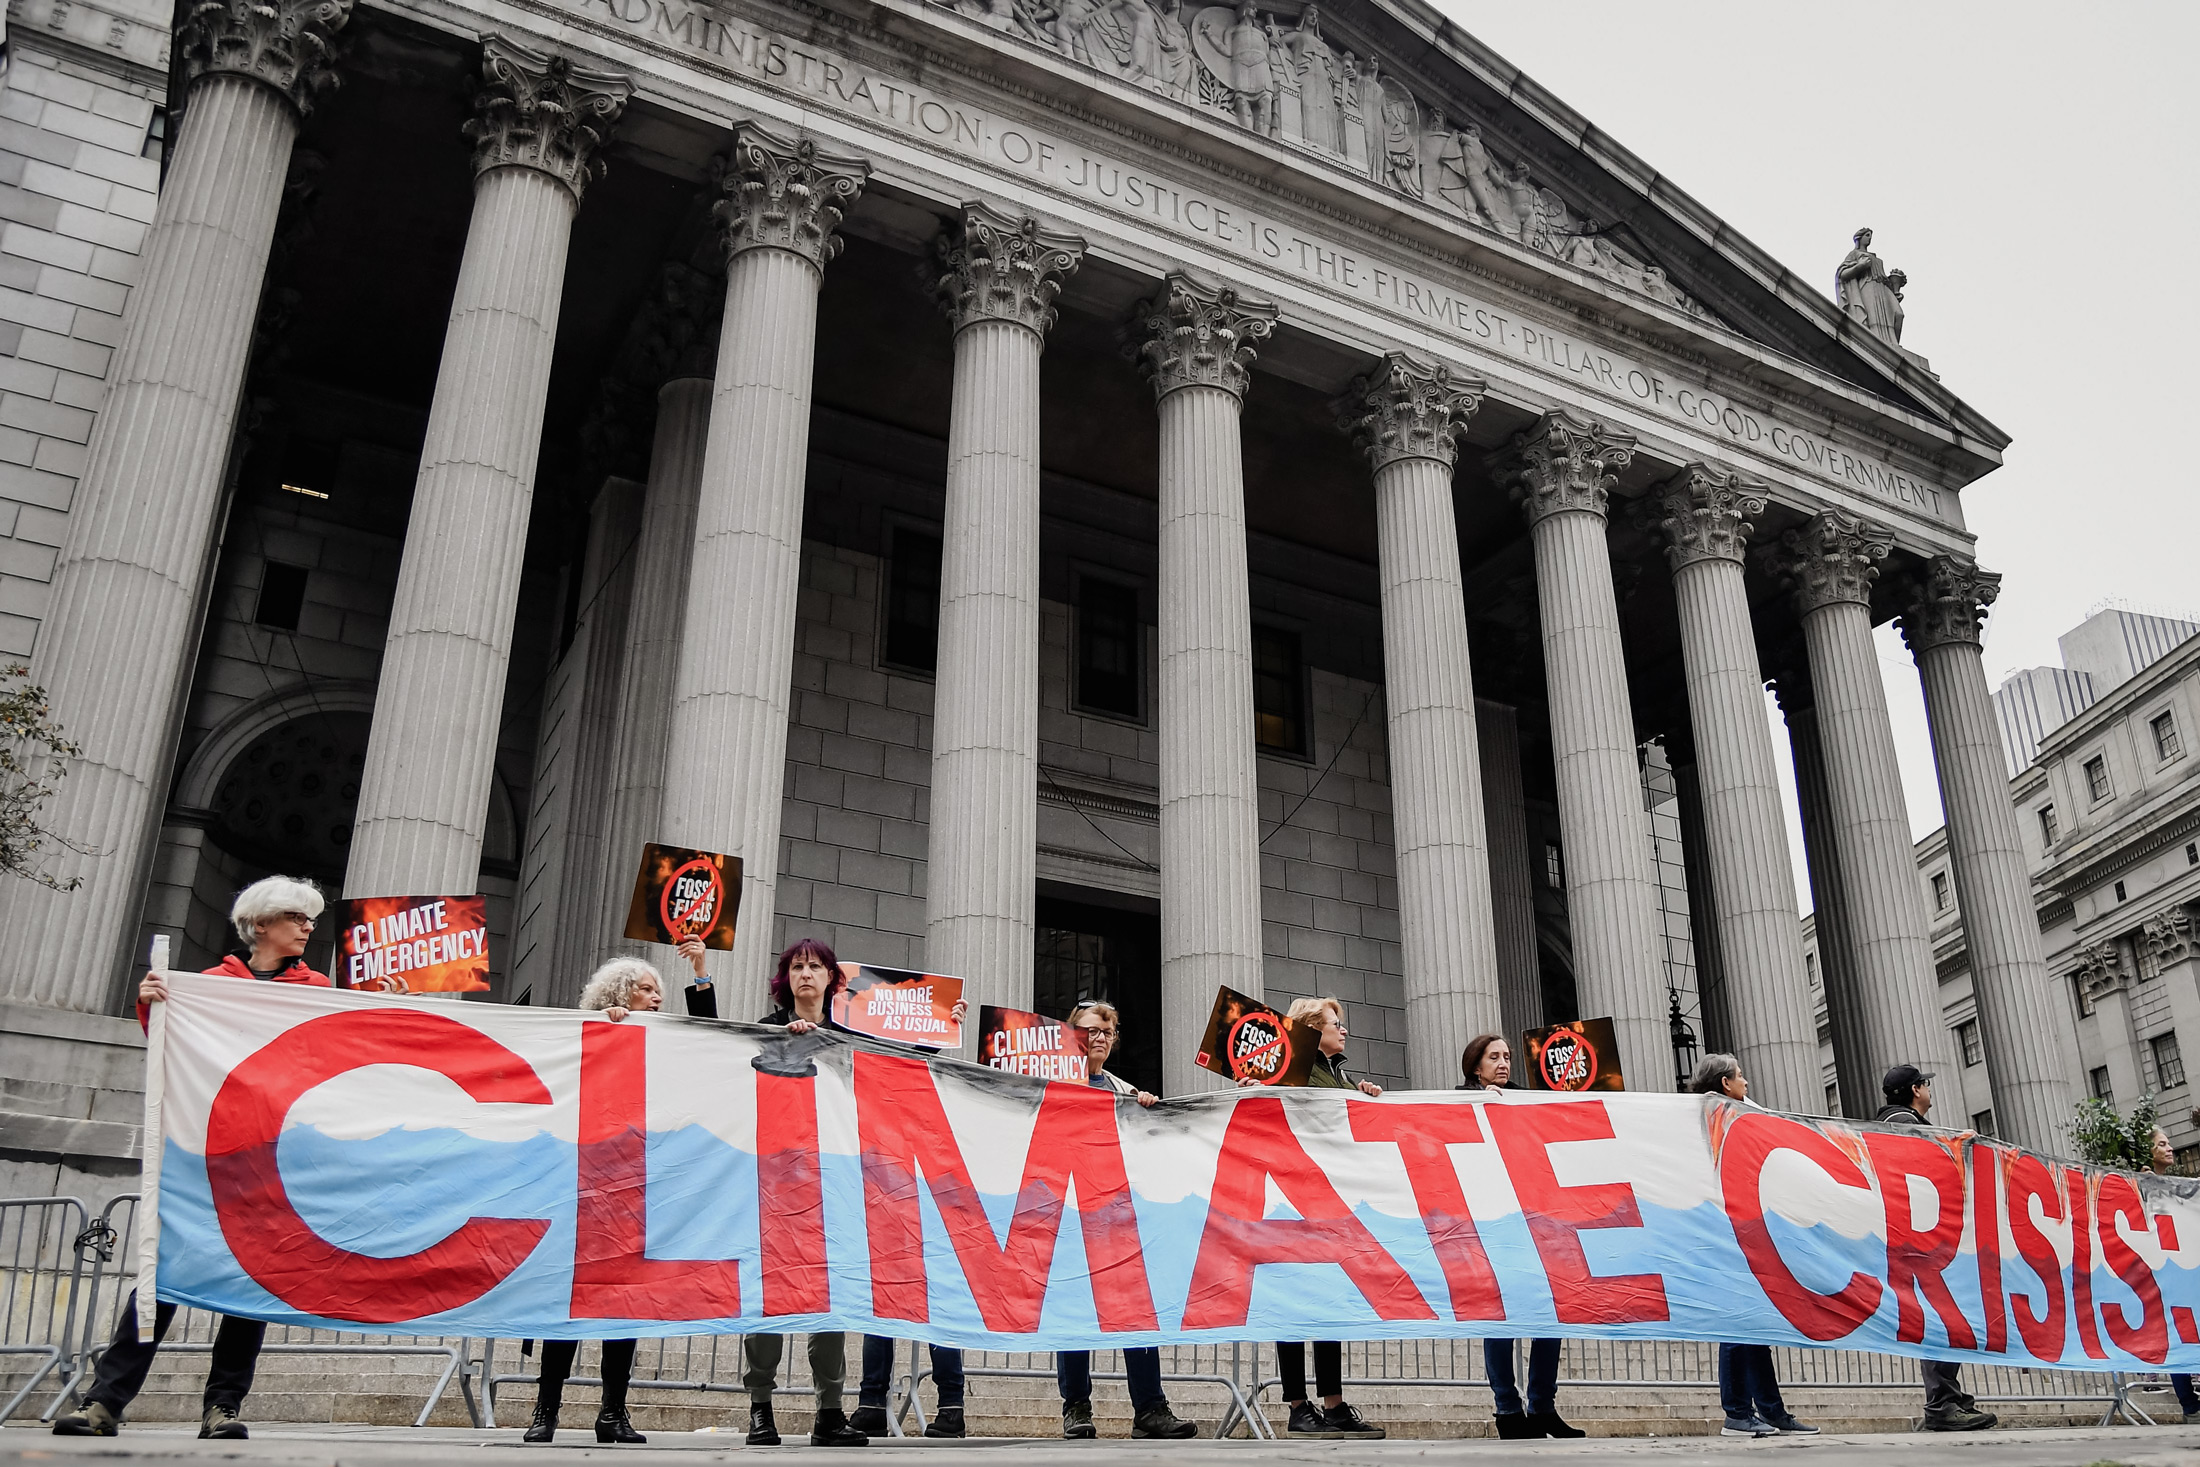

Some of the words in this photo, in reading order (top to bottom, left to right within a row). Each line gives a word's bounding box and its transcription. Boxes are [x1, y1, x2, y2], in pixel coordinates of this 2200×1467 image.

[1000, 131, 1055, 173] OF
[1066, 157, 1233, 242] JUSTICE
[1249, 220, 1281, 258] IS
[1292, 237, 1359, 288] THE
[1372, 268, 1509, 346] FIRMEST
[1521, 326, 1622, 390] PILLAR
[1627, 369, 1665, 405] OF
[1678, 389, 1762, 442] GOOD
[1771, 426, 1942, 516] GOVERNMENT
[353, 900, 449, 954] CLIMATE
[350, 926, 487, 985] EMERGENCY
[867, 1000, 933, 1017] BUSINESS
[875, 988, 894, 1002] NO
[895, 985, 934, 1004] MORE
[882, 1015, 902, 1031] AS
[904, 1016, 949, 1034] USUAL
[993, 1024, 1063, 1058] CLIMATE
[205, 1008, 1670, 1333] CLIMATE
